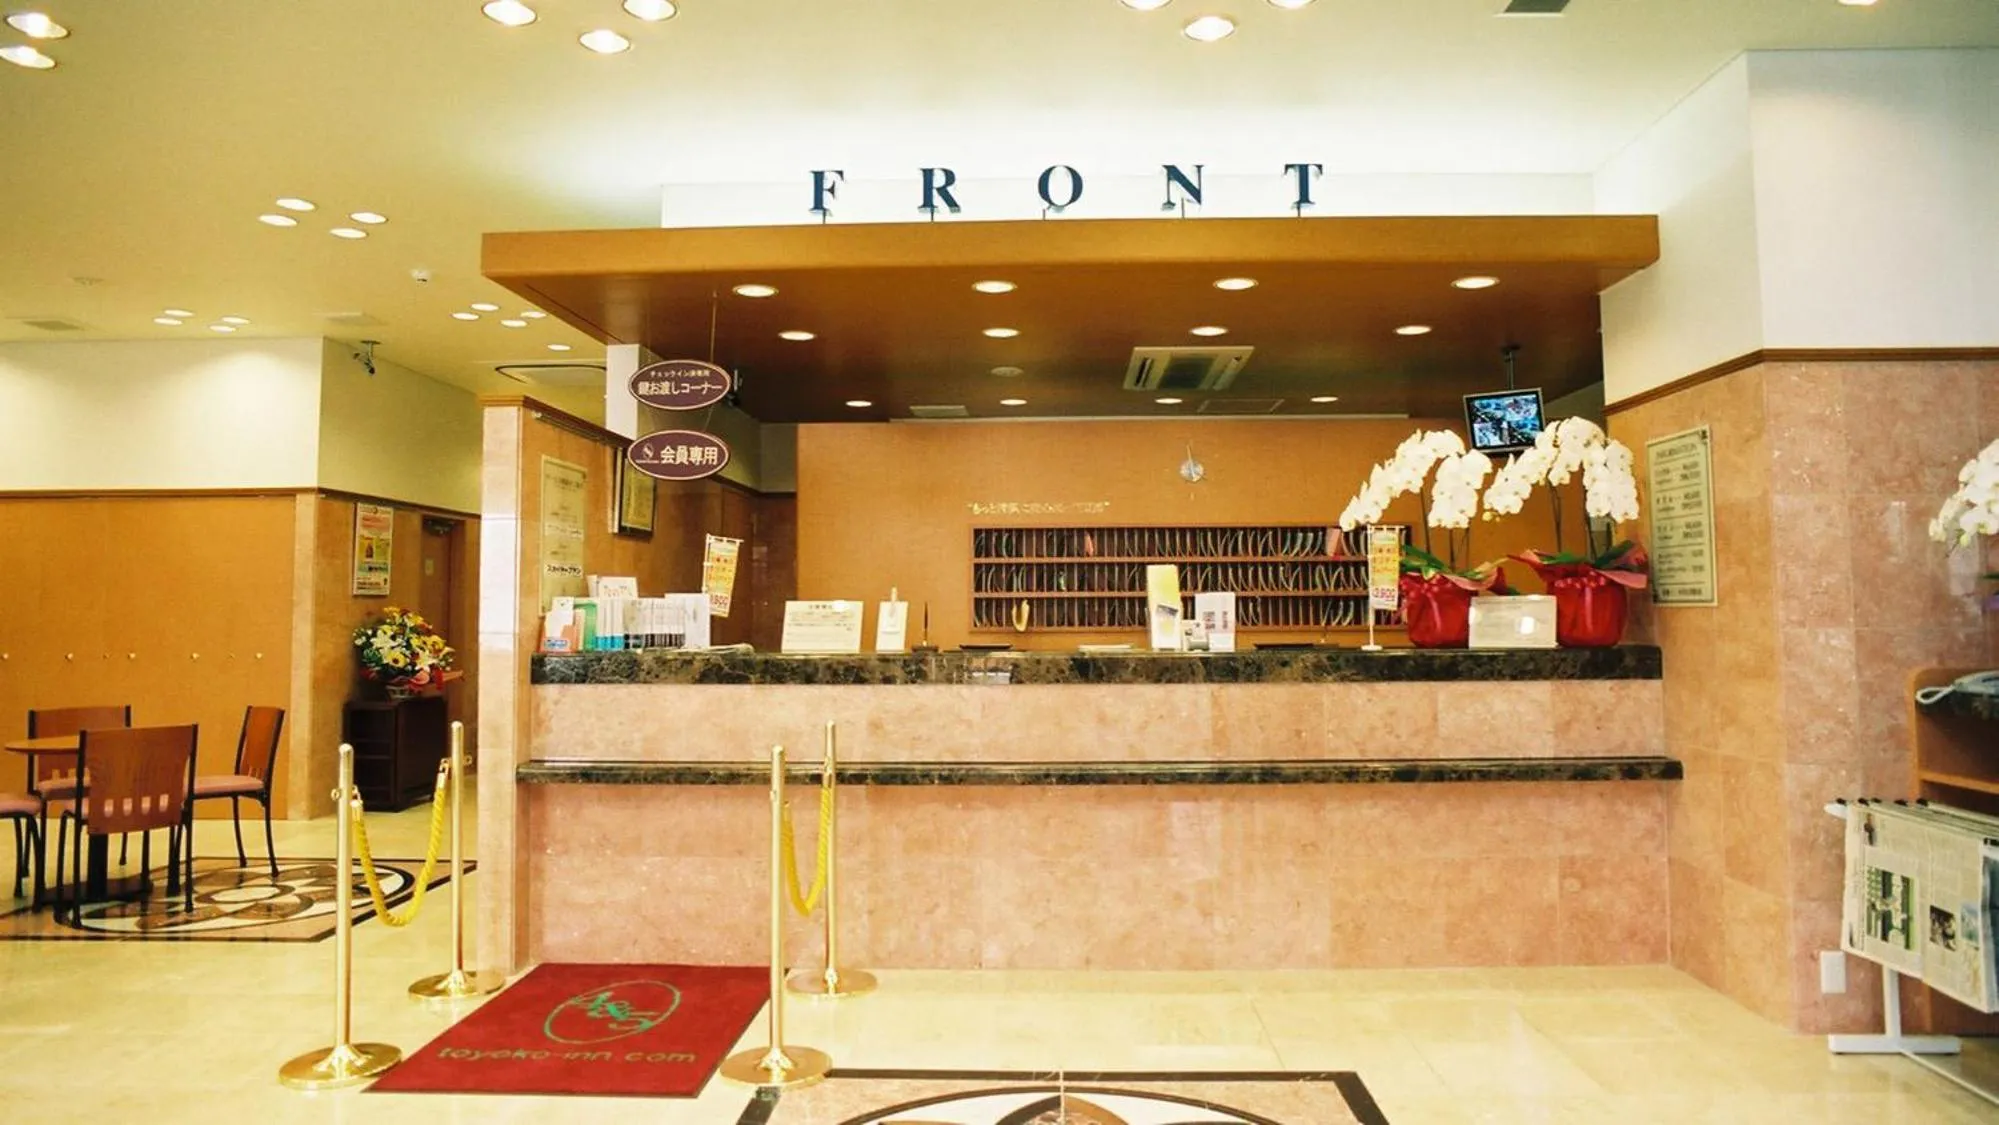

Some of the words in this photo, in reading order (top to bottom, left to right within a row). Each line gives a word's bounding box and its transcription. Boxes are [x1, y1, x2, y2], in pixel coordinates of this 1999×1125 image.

[808, 163, 1324, 215] FRONT
[660, 445, 718, 466] 会員専用
